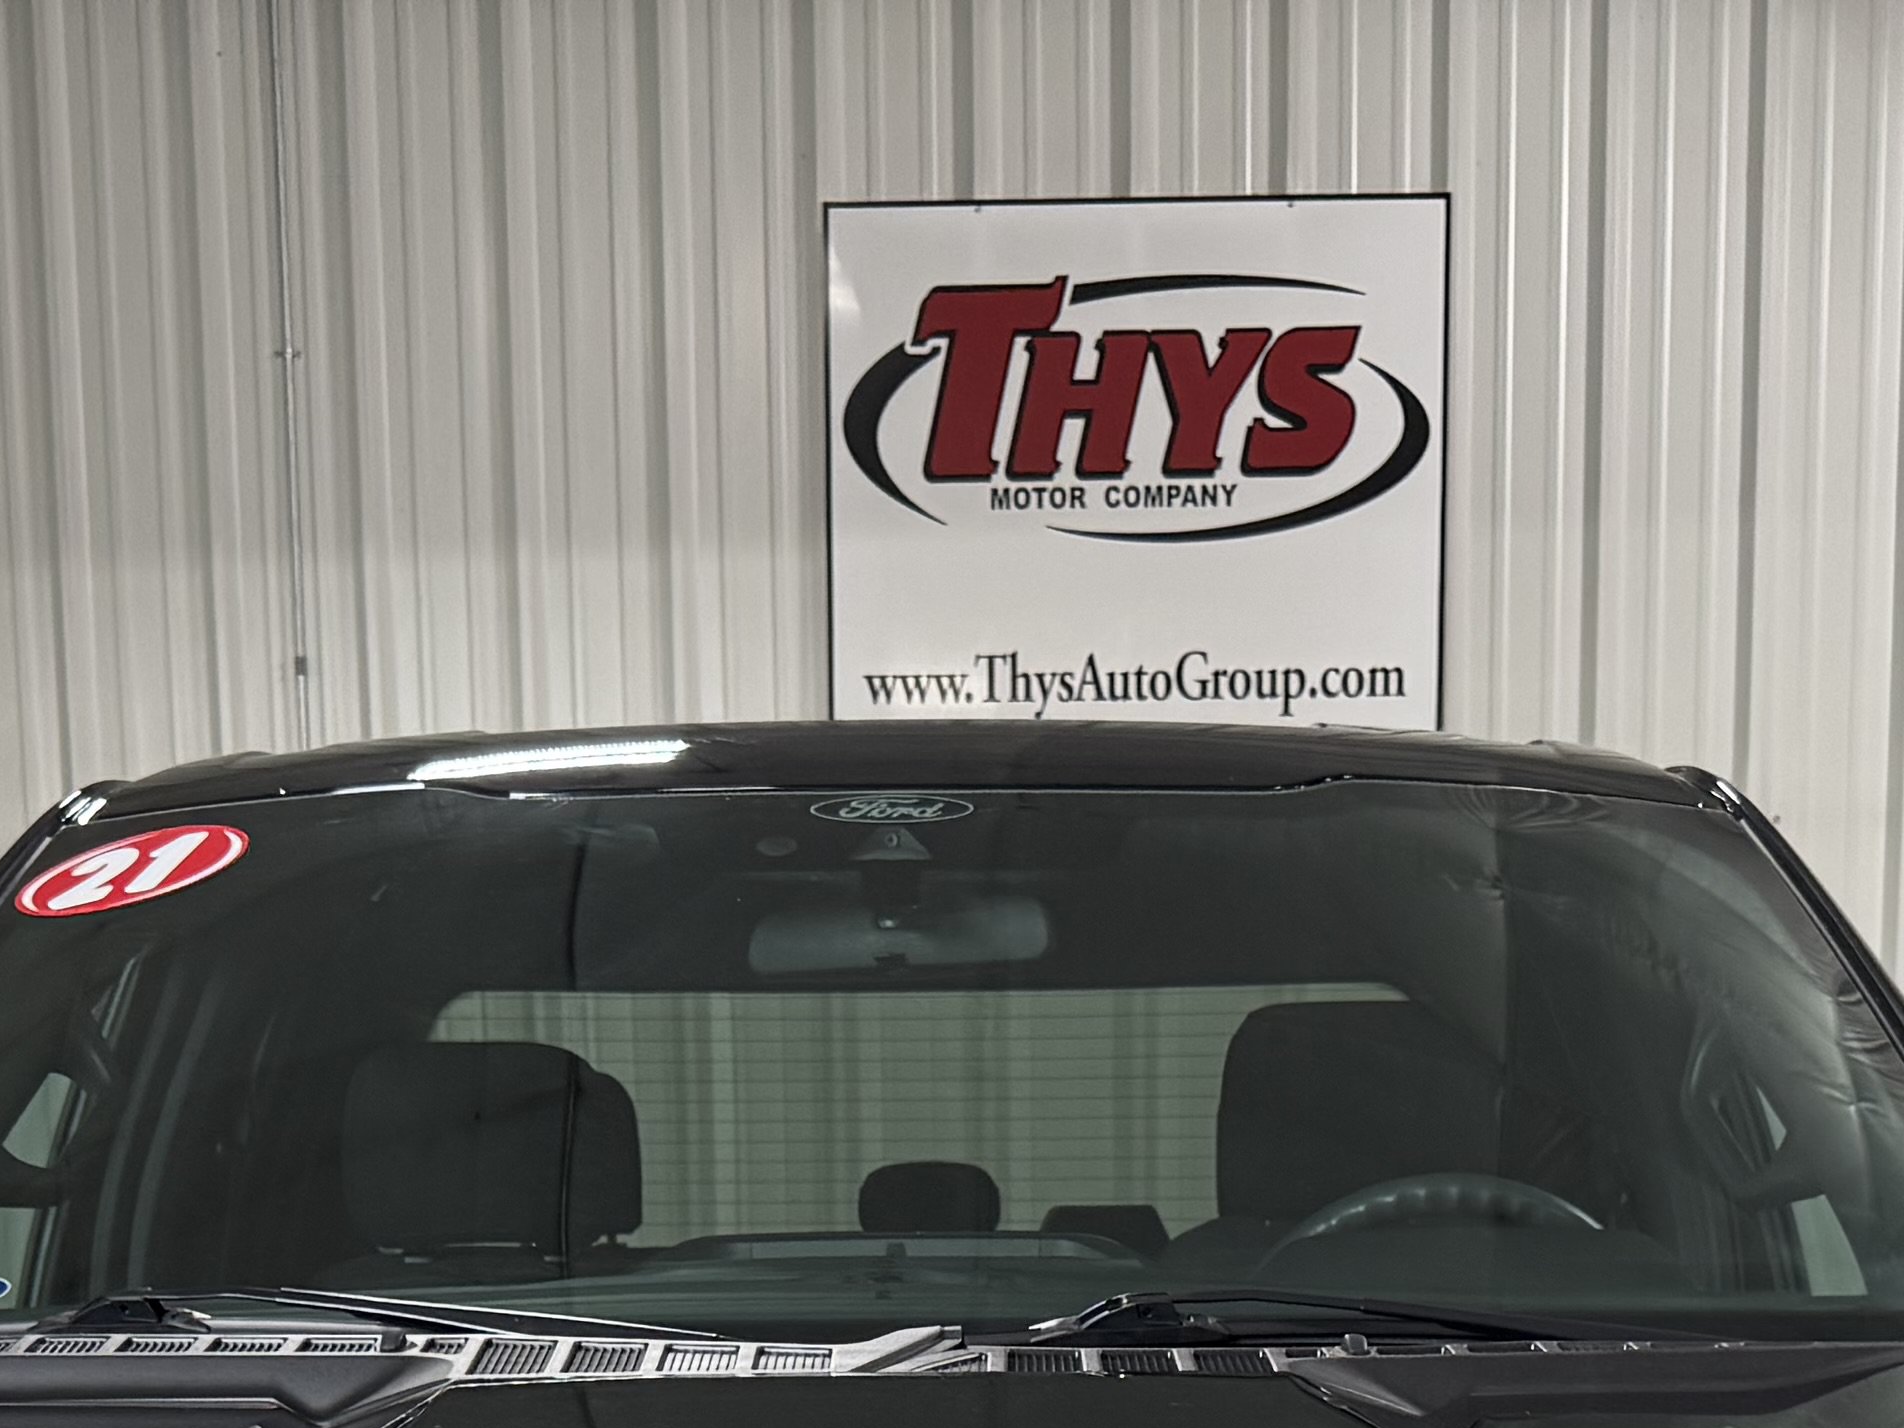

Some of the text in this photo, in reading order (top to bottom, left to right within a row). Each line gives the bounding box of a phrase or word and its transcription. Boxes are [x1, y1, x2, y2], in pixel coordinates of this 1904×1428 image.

[911, 274, 1363, 484] THYS
[990, 483, 1238, 511] MOTOR COMPANY
[863, 649, 1406, 720] www.ThysAutoGroup.com
[838, 799, 945, 819] Ford
[46, 830, 210, 911] 21
